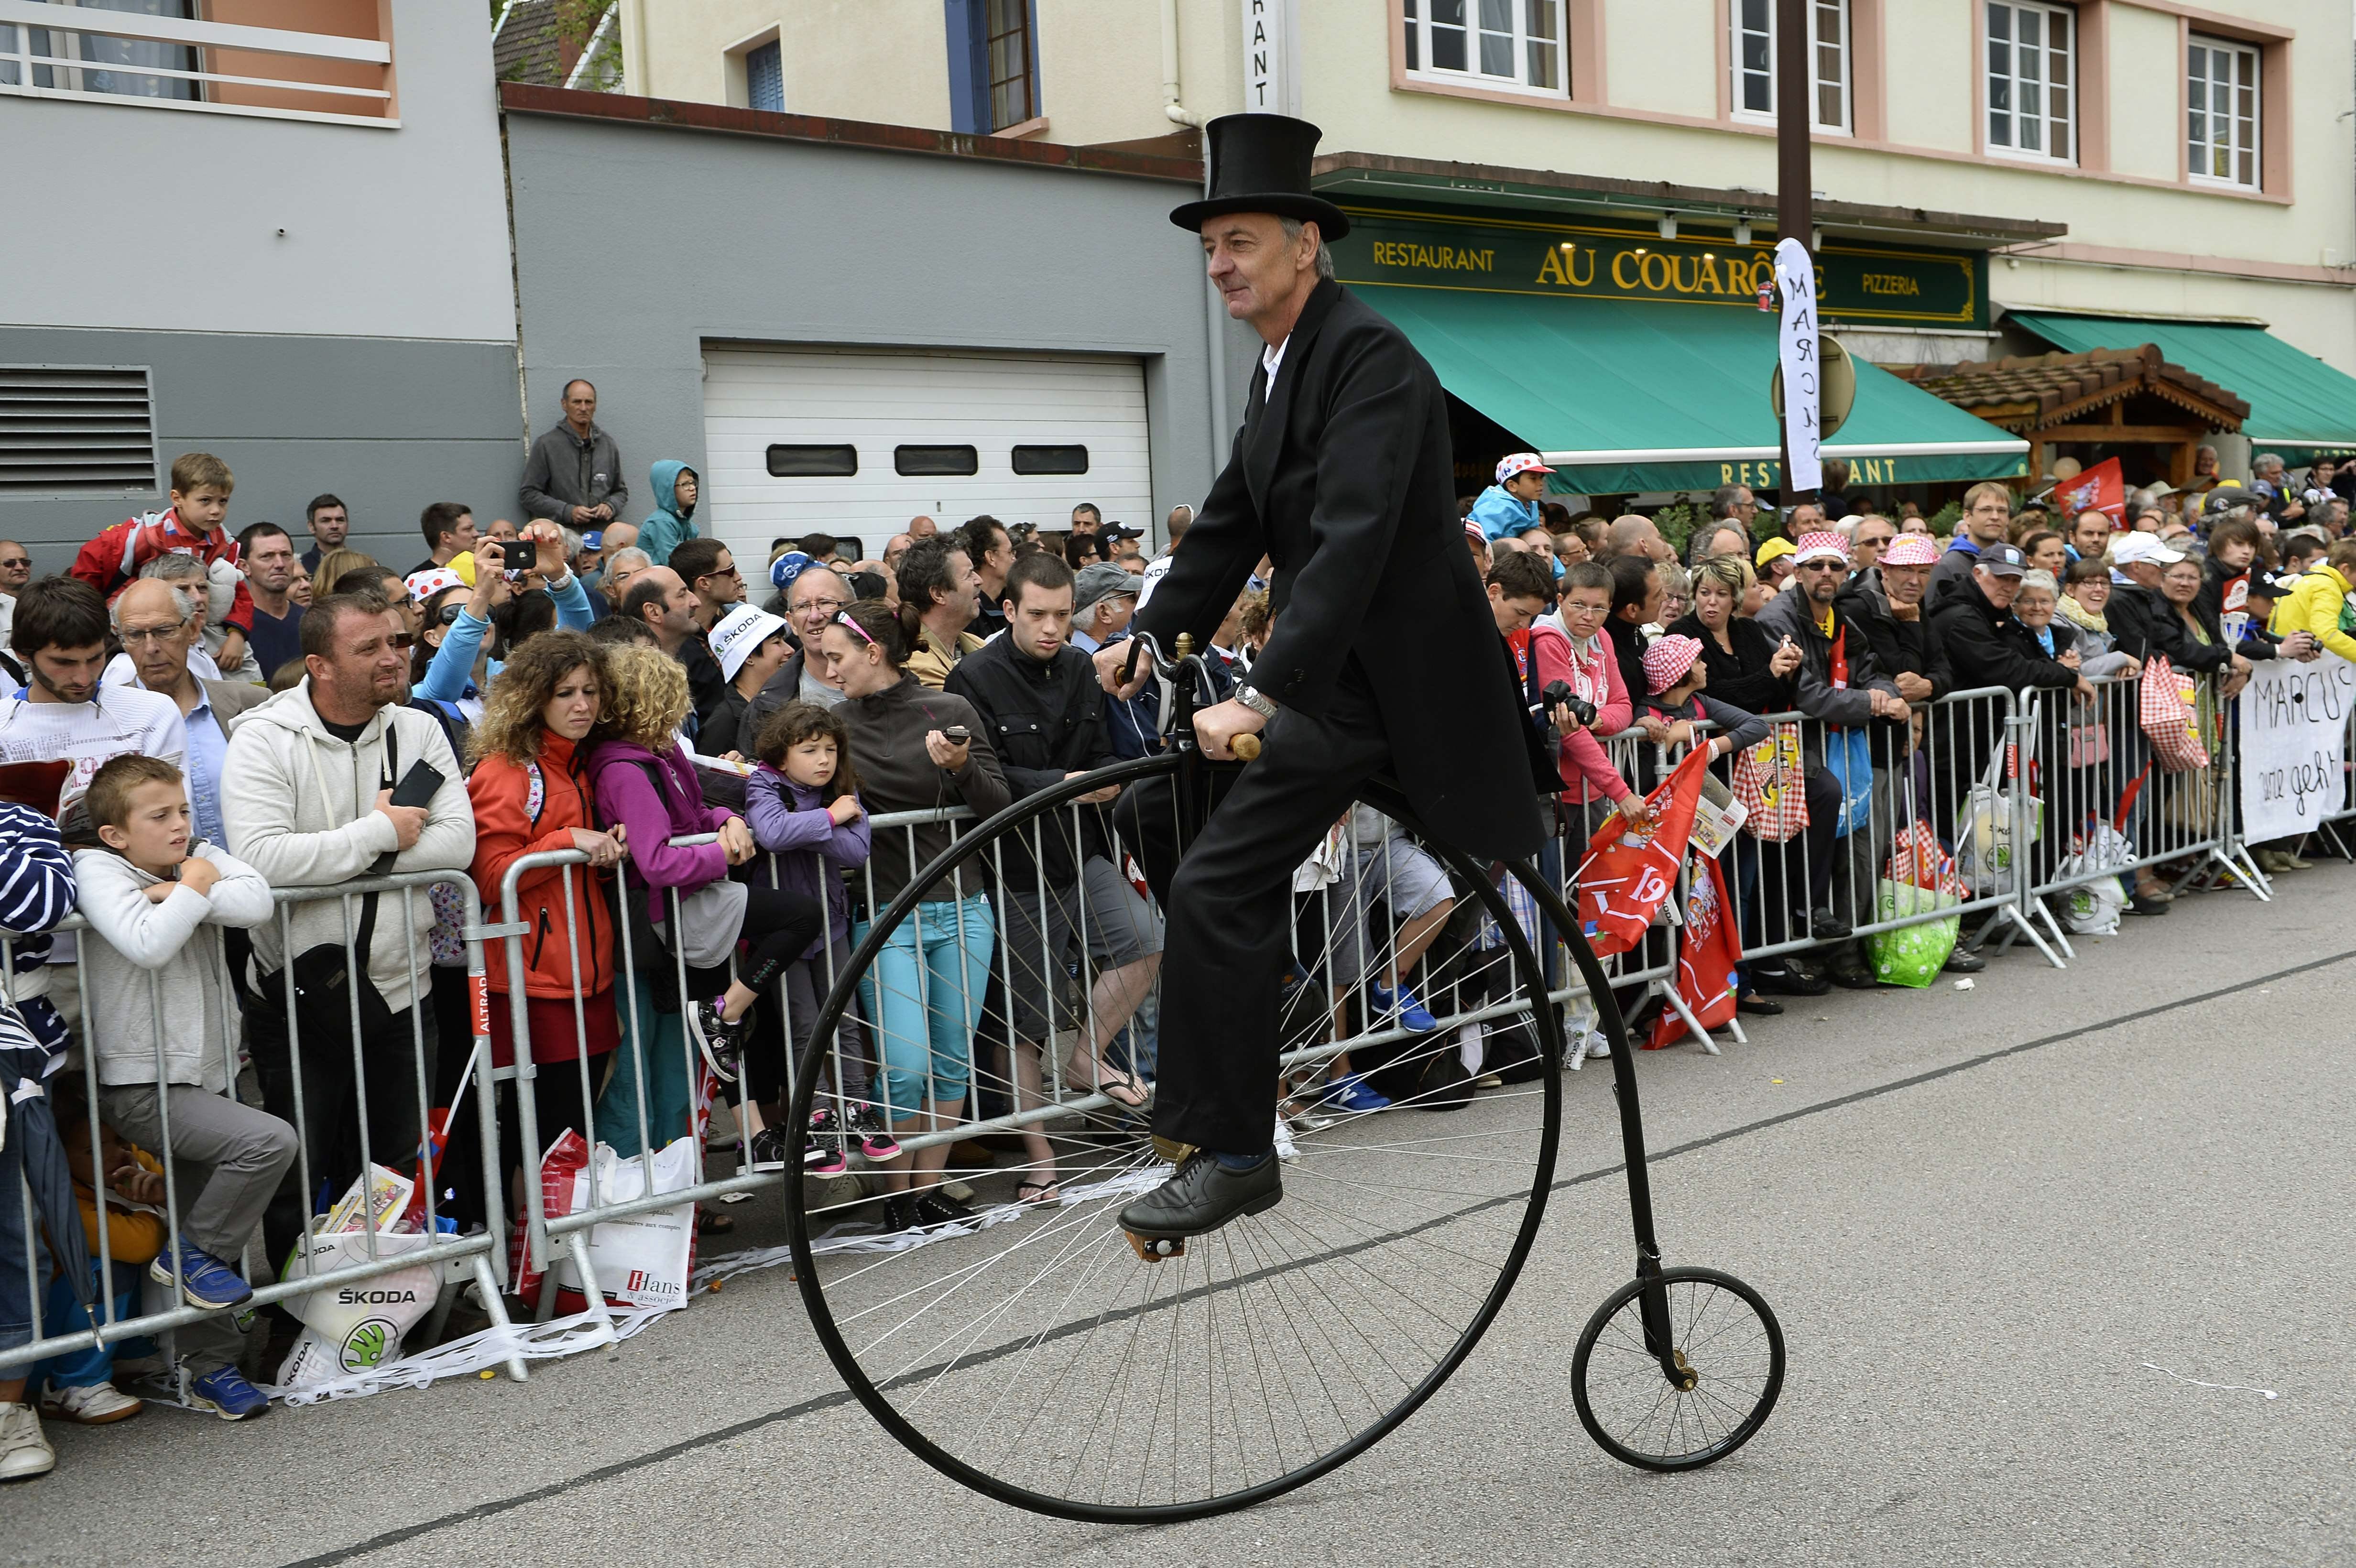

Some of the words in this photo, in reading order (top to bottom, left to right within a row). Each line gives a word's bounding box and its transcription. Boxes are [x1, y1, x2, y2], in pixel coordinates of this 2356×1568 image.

[1374, 242, 1494, 272] RESTAURANT
[1536, 246, 1596, 286] AU
[1612, 251, 1827, 300] COUARÔE
[1863, 273, 1920, 295] PIZZERIA
[1721, 459, 1895, 488] RESANT
[724, 614, 762, 645] ŠKODA
[479, 977, 490, 1033] ALTRAD
[338, 1288, 416, 1304] ŠKODA
[627, 1270, 680, 1295] Hans
[638, 1294, 679, 1304] associé
